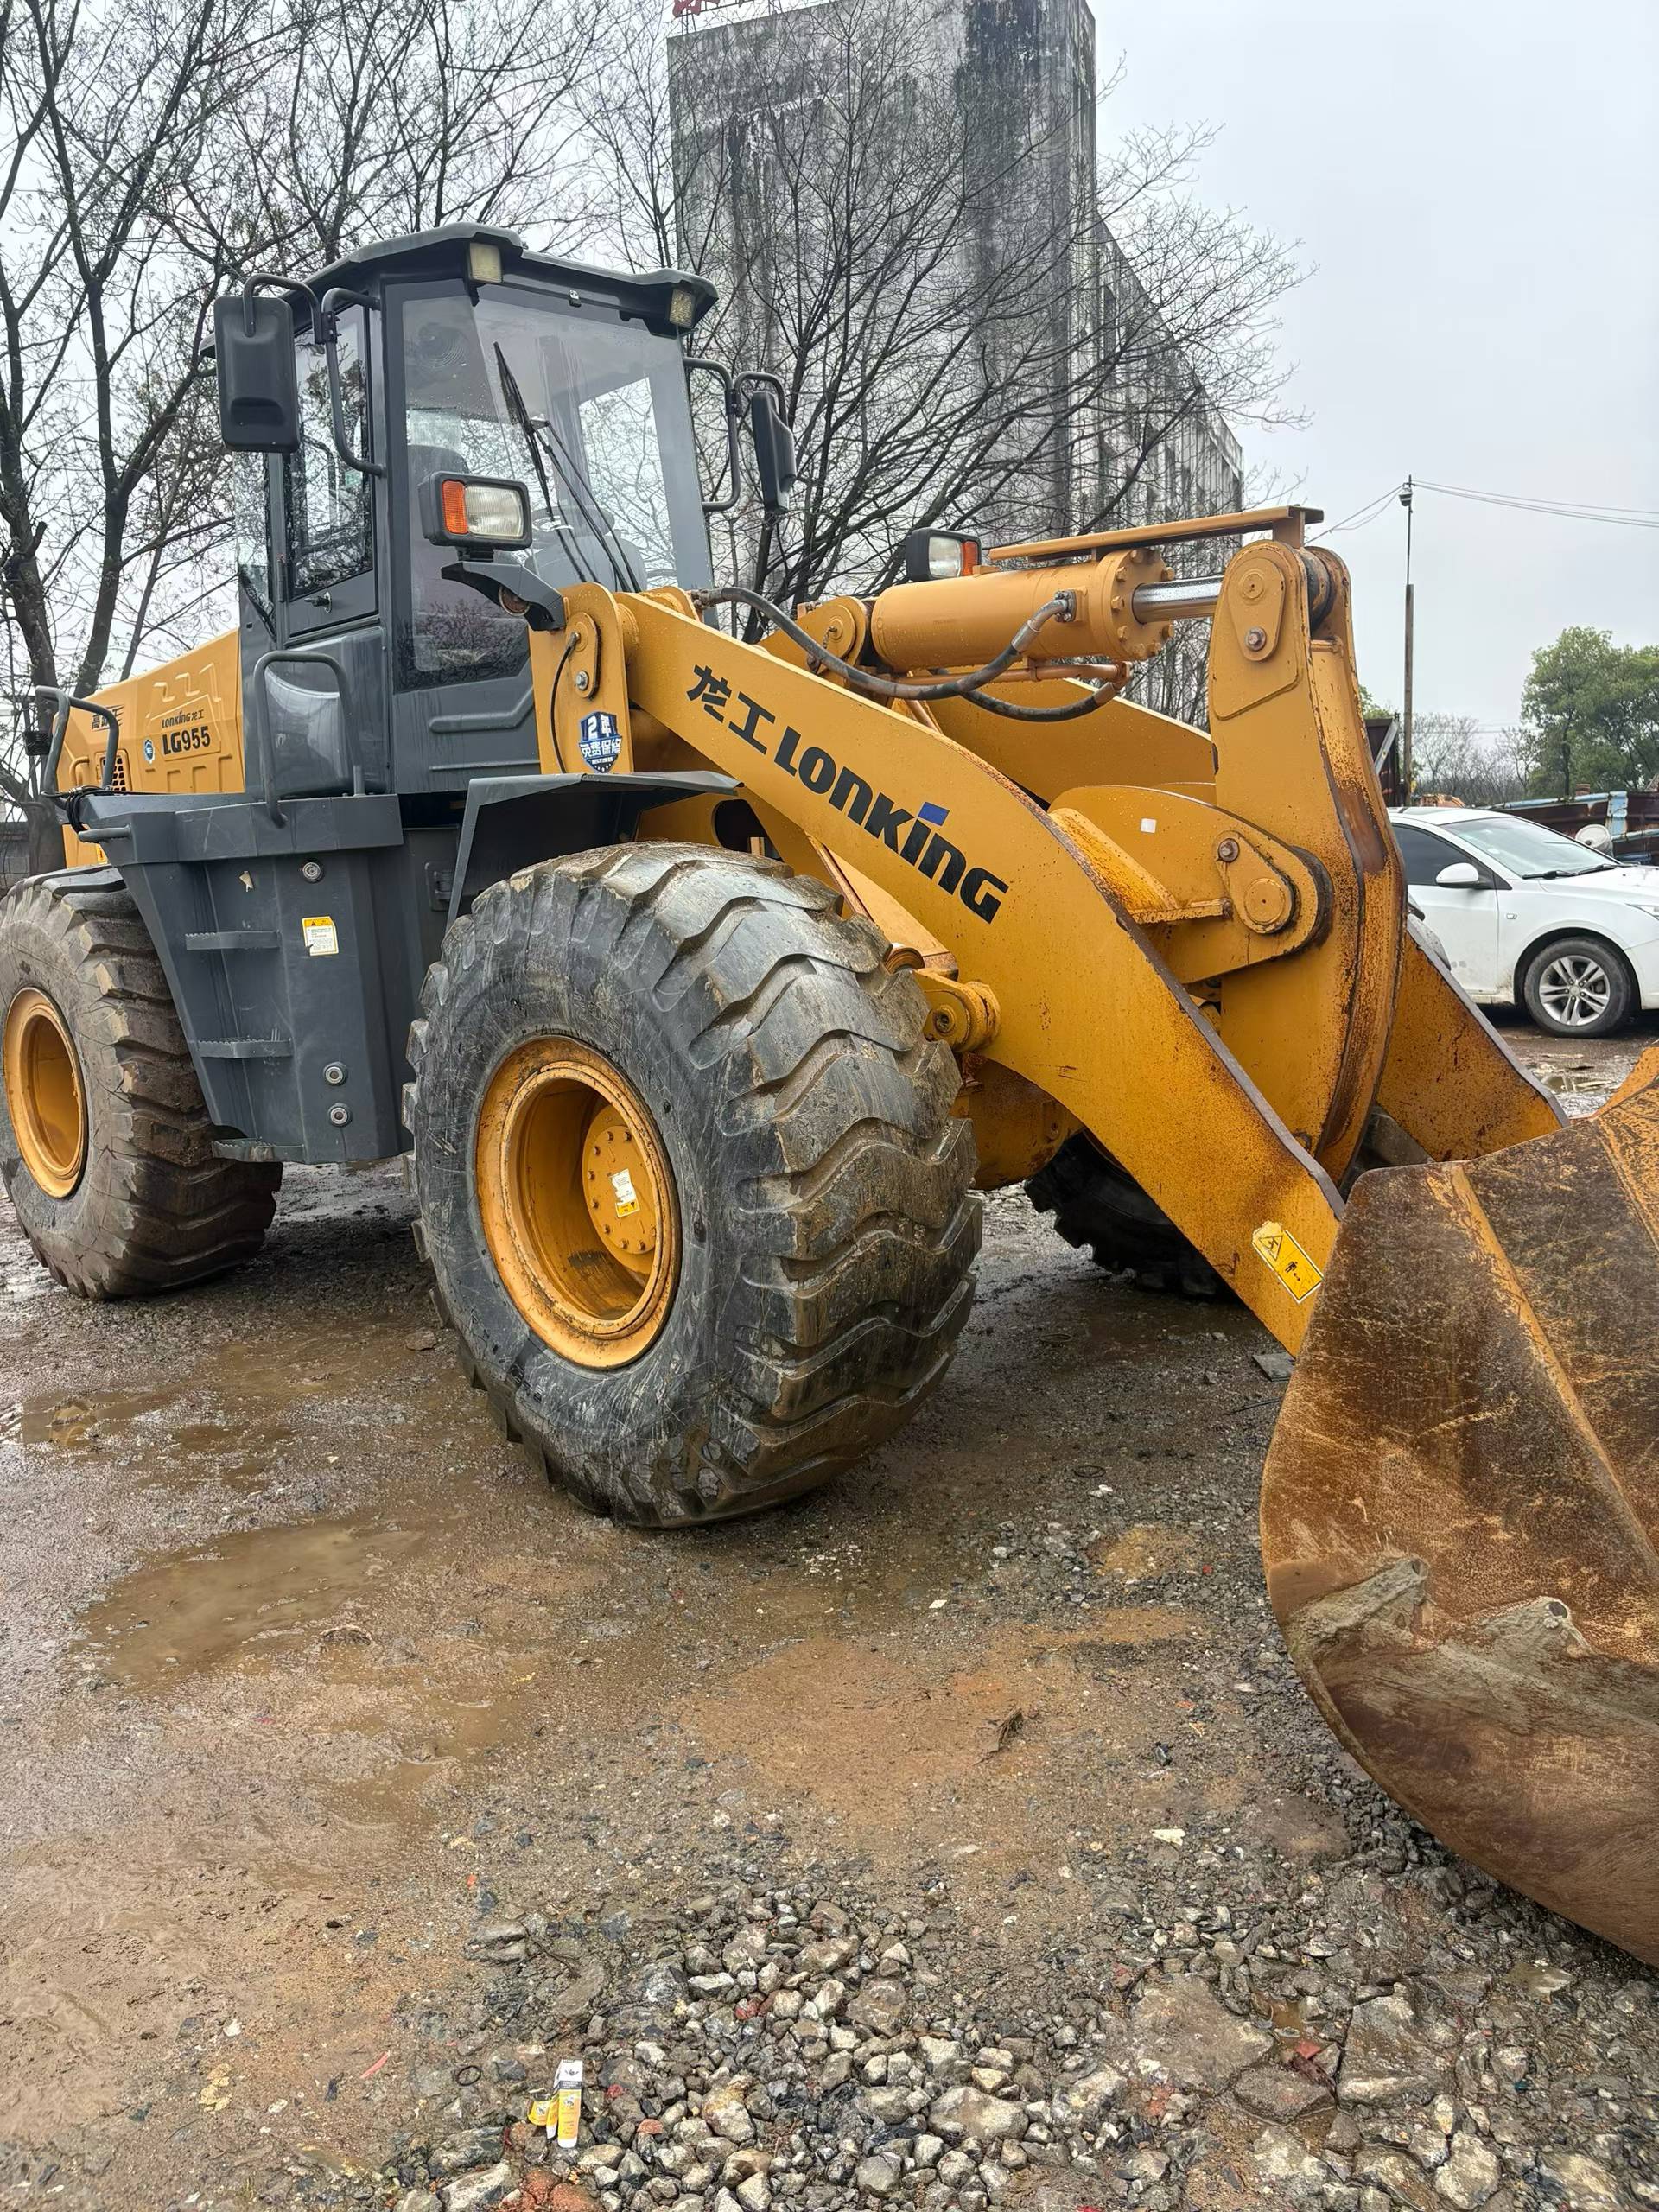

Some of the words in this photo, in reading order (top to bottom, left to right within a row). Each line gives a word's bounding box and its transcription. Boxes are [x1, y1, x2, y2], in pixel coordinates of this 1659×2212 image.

[686, 664, 777, 755] 龙工
[162, 725, 211, 756] LG955
[588, 714, 612, 740] 2年
[580, 738, 622, 758] 免费保修
